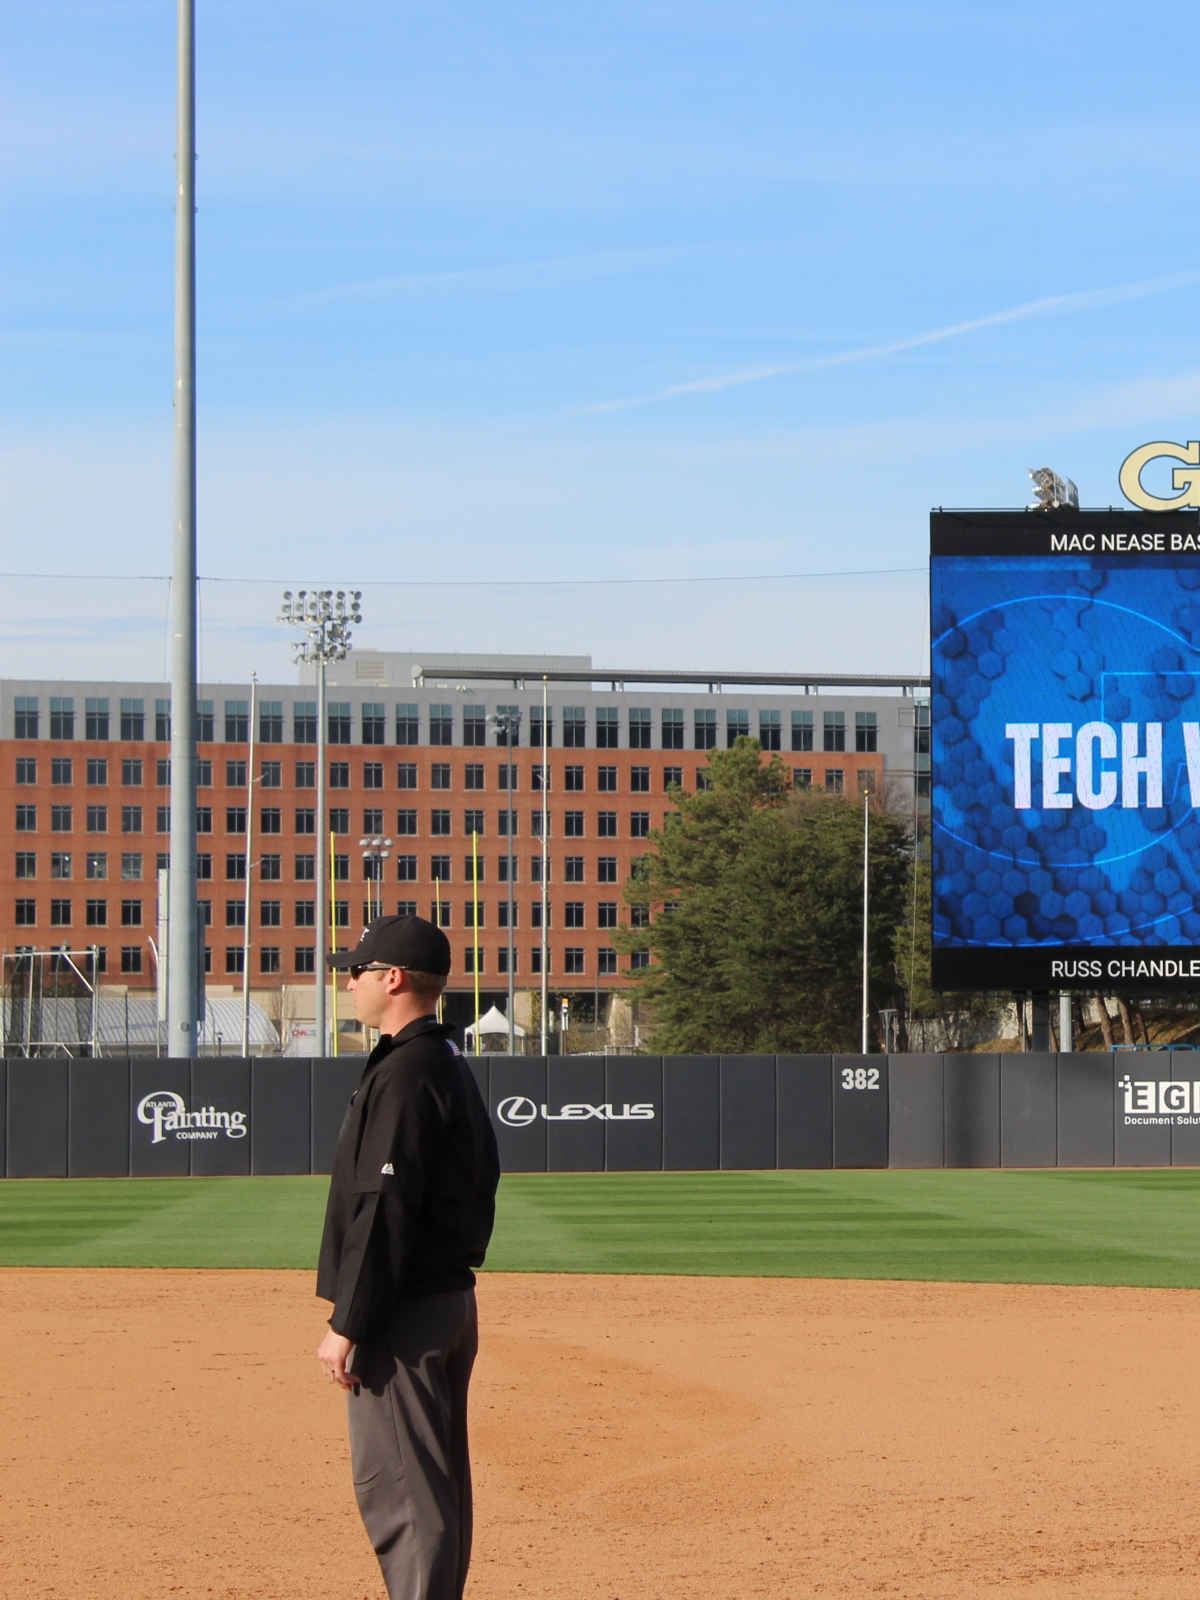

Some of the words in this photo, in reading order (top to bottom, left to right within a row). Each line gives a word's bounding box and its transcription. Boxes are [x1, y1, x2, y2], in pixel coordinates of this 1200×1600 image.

[1050, 533, 1096, 551] MAC
[1101, 533, 1166, 551] NEASE
[1005, 721, 1163, 810] TECH
[1051, 960, 1103, 978] RUSS
[841, 1068, 880, 1090] 382
[145, 1100, 178, 1109] ATLANTA
[540, 1103, 655, 1121] LEXUS
[137, 1091, 247, 1144] Painting
[1124, 1115, 1174, 1125] Document
[175, 1131, 218, 1140] COMPANY
